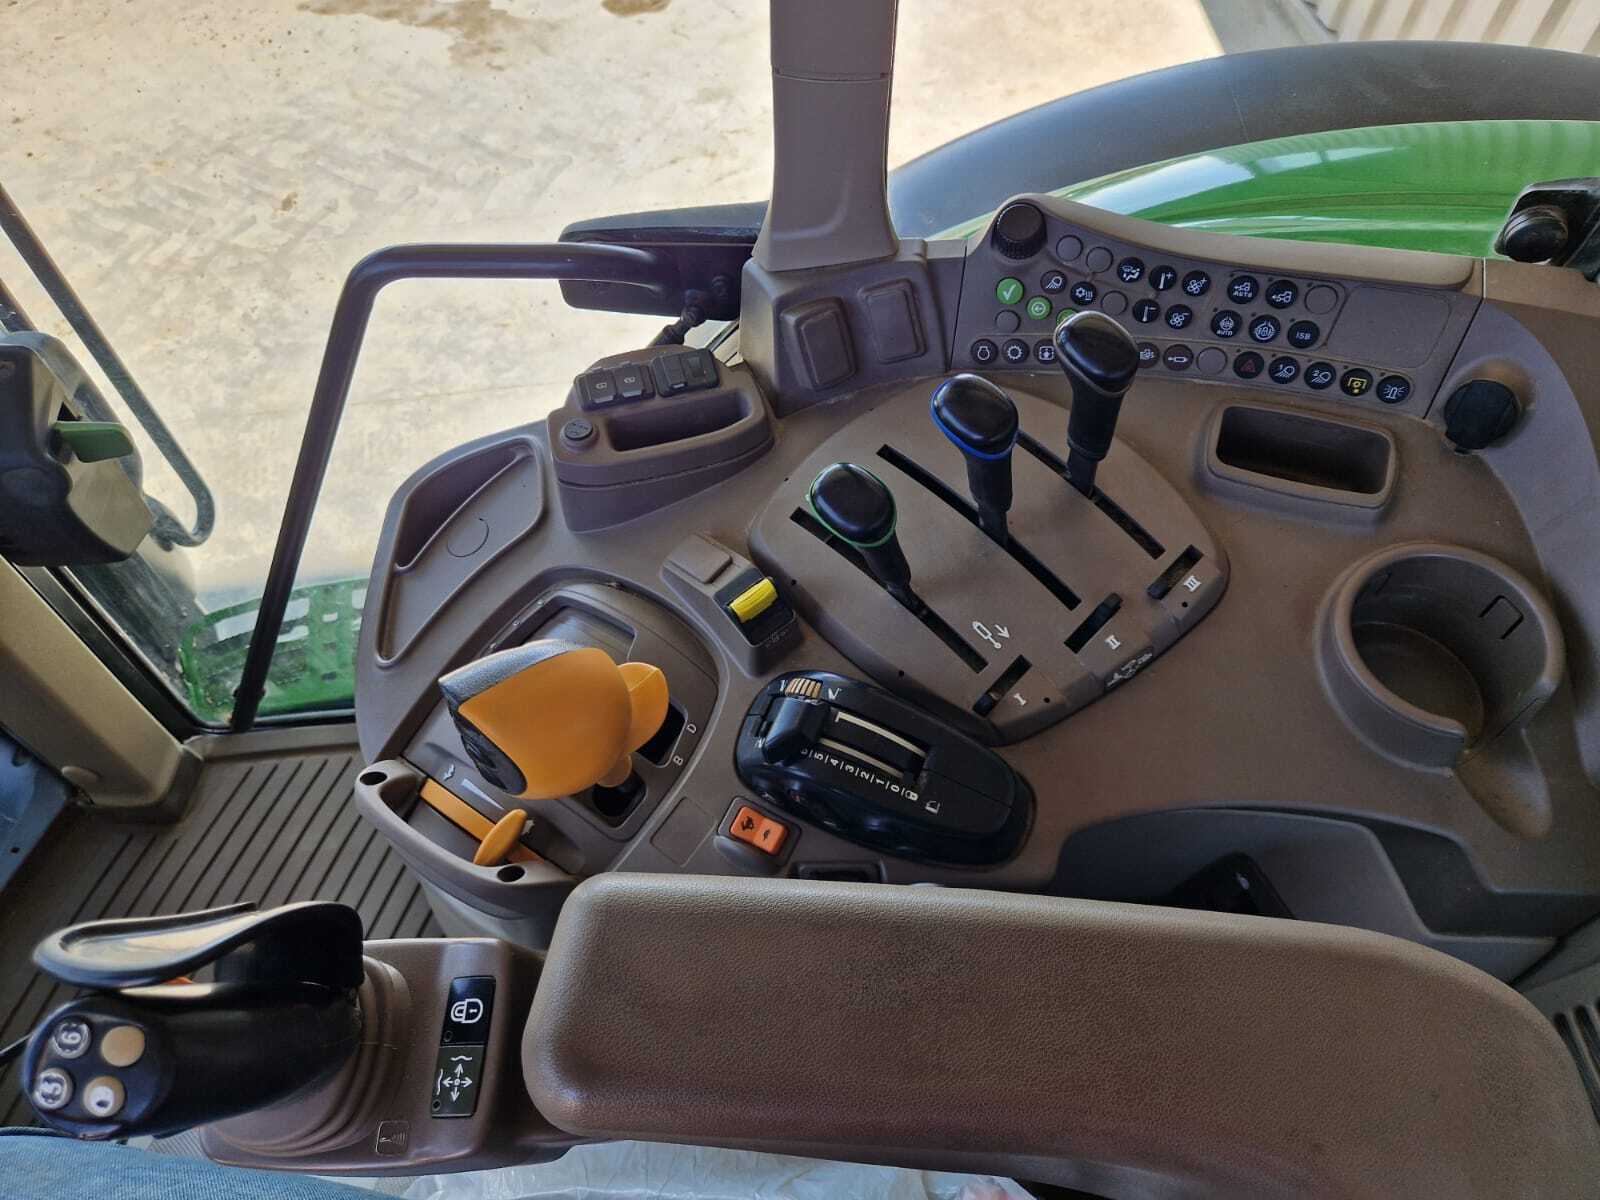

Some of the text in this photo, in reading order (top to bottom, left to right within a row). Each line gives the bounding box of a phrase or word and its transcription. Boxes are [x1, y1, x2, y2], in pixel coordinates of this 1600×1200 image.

[686, 723, 697, 734] D
[814, 752, 824, 760] 5
[673, 755, 684, 766] B
[830, 758, 839, 766] 4
[844, 765, 854, 773] 3
[860, 771, 870, 780] 2
